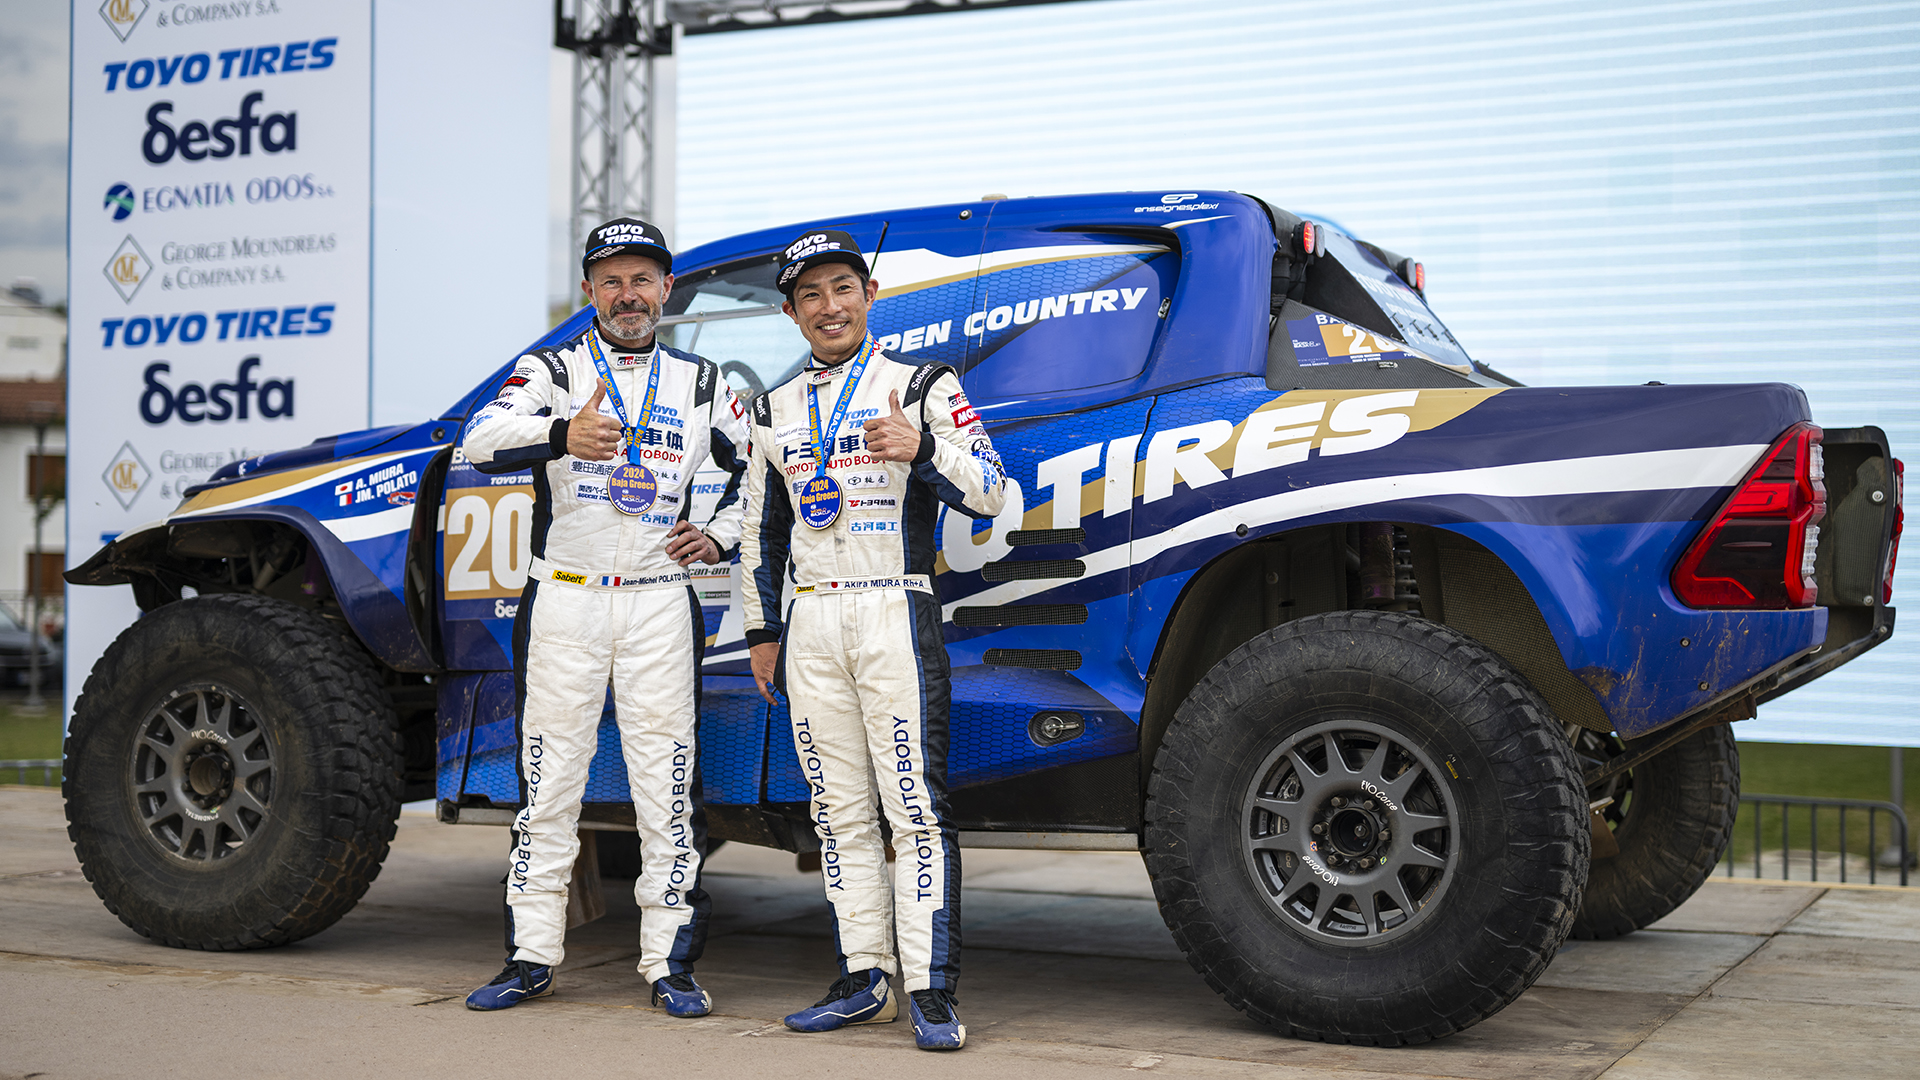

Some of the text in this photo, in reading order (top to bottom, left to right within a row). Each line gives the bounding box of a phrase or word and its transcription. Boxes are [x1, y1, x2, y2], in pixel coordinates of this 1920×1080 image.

[172, 3, 250, 25] COMPANY
[103, 37, 338, 92] TOYO TIRES
[143, 181, 235, 213] EGNATIA
[245, 173, 315, 205] ODOS
[598, 224, 644, 240] TOYO
[161, 232, 336, 265] GEORGE MOUNDREAS
[785, 234, 828, 260] TOYO
[176, 264, 256, 289] COMPANY
[102, 302, 336, 350] TOYO TIRES
[878, 320, 952, 353] PEN
[964, 287, 1149, 337] COUNTRY
[698, 361, 712, 390] Sabelt
[911, 364, 934, 391] Sabelt
[602, 372, 620, 407] WORLD
[836, 378, 857, 412] WORLD
[651, 415, 684, 428] TIRES
[653, 404, 678, 417] OYO
[844, 408, 880, 421] TOYO
[160, 450, 224, 474] GEORGE
[620, 449, 653, 460] ATO
[654, 450, 684, 464] BODY
[1036, 390, 1420, 532] TIRES
[355, 463, 404, 490] A. MIURA
[355, 488, 375, 504] JM.
[376, 470, 418, 498] POLATO
[490, 475, 534, 485] TOYO TIR
[612, 478, 655, 490] Baja Greece
[623, 467, 645, 480] 2024
[810, 479, 829, 493] 2024
[802, 490, 838, 504] Baja Greece
[447, 491, 534, 592] 20
[555, 571, 584, 584] Sabelt
[622, 577, 658, 586] Jean-Michel
[659, 573, 681, 584] POLATO
[870, 580, 900, 588] MIURA
[892, 716, 913, 772] BODY
[528, 734, 544, 807] TOYOTA
[796, 718, 826, 797] TOYOTA
[824, 838, 845, 892] BODY
[900, 777, 928, 827] AUTO
[664, 741, 690, 907] OYOTA AUTO BODY
